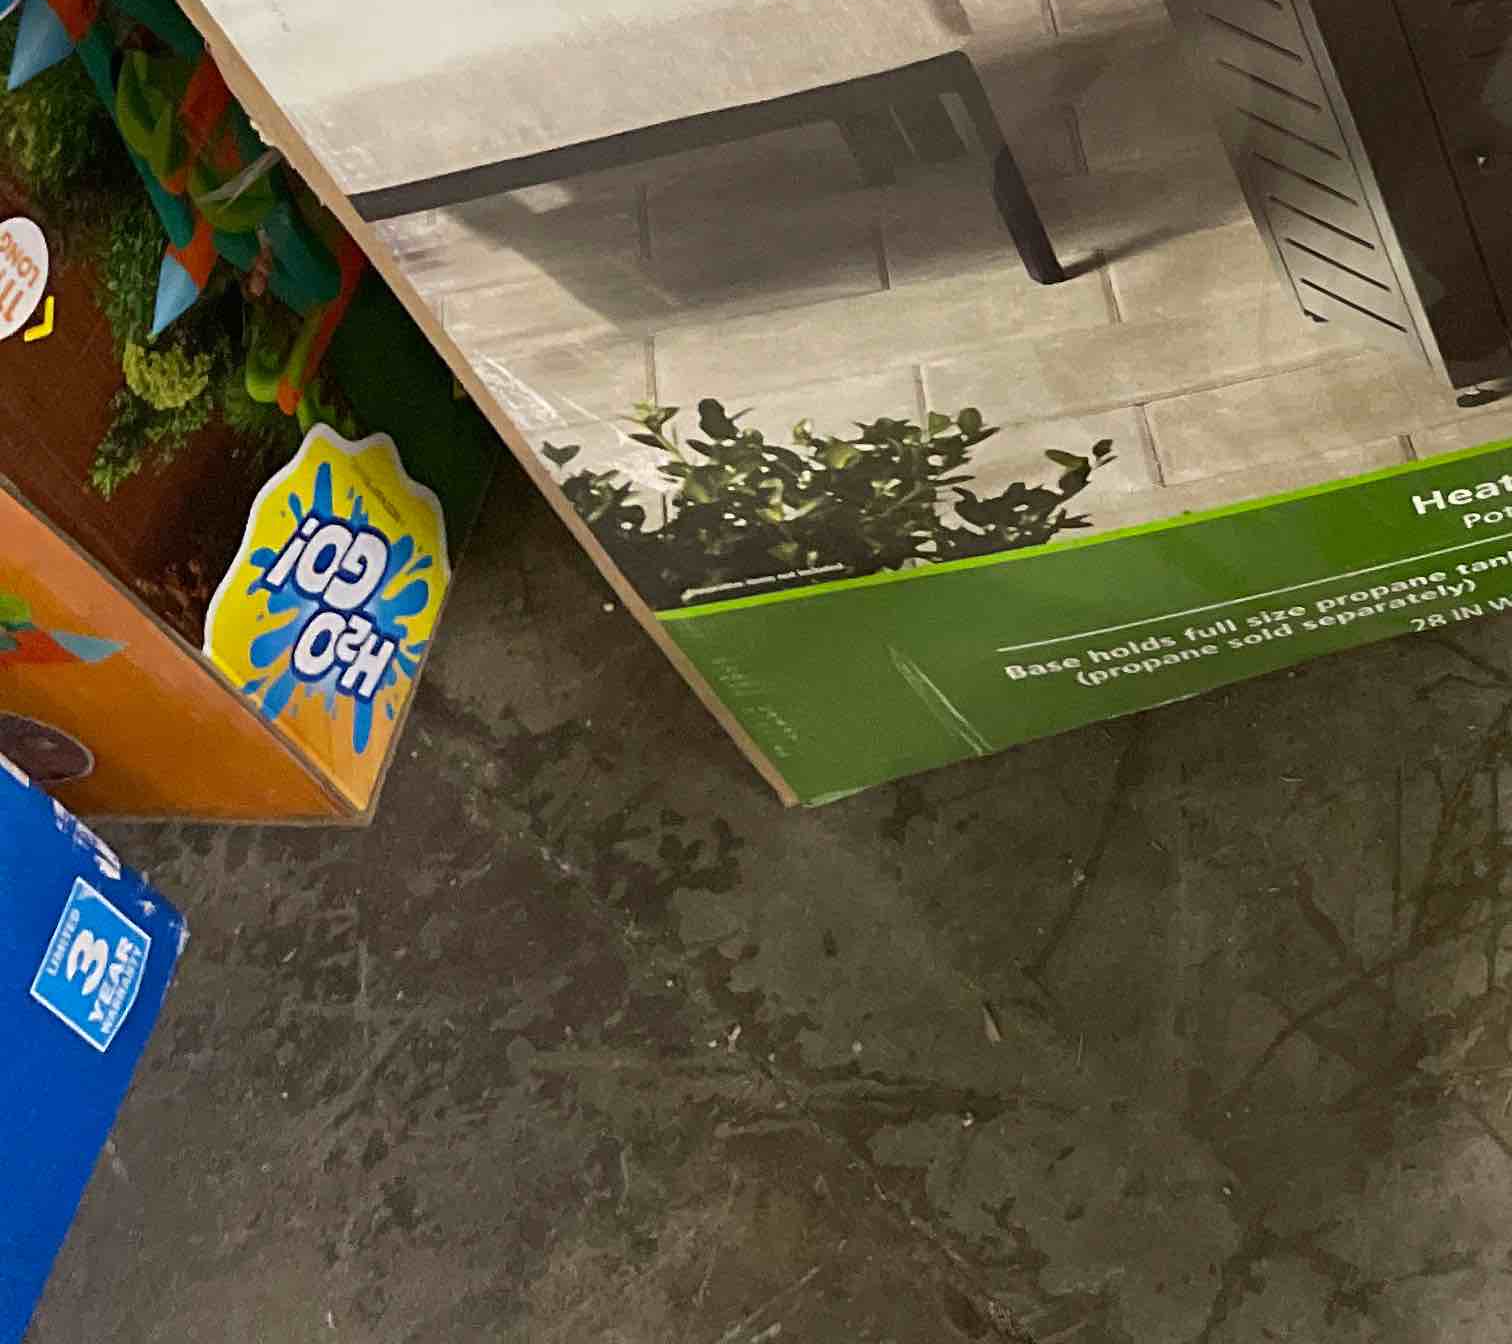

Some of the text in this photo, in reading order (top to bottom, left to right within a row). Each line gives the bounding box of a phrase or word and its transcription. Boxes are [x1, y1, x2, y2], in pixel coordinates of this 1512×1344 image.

[266, 516, 388, 610] GO!
[1003, 655, 1081, 681] Base
[1088, 634, 1177, 666] holds
[1184, 618, 1237, 643] full
[1246, 605, 1307, 632] size
[1316, 569, 1448, 613] propane
[1075, 578, 1478, 688] (propane sold separately)
[1451, 602, 1484, 622] IN
[66, 929, 109, 996] 3
[88, 936, 137, 1022] YEAR
